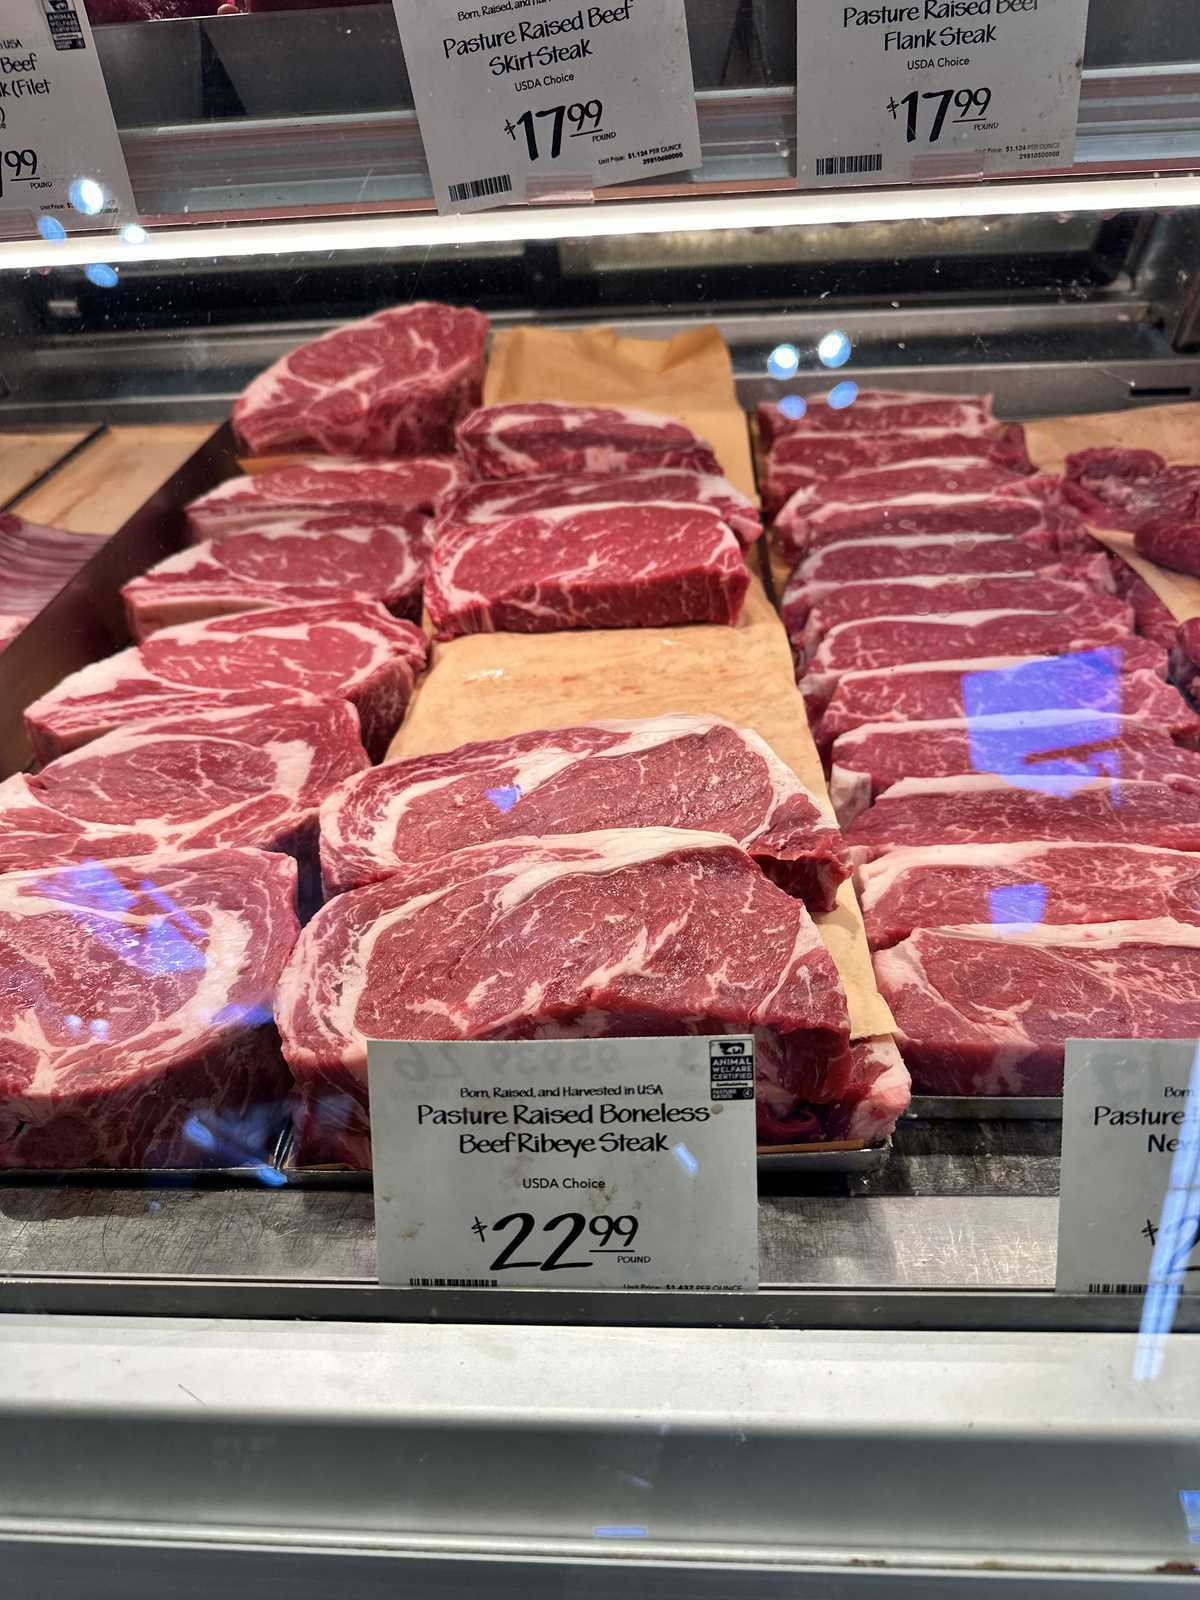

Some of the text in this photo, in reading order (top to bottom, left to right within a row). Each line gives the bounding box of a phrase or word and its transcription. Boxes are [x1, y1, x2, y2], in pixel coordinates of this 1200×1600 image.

[843, 5, 919, 27] Pasture
[924, 0, 990, 20] Raised
[443, 0, 635, 59] Pasture Raised Beef
[884, 24, 997, 51] Flank Steak
[3, 39, 23, 49] USA
[1, 53, 38, 73] Beef
[489, 39, 593, 76] Skirt Steak
[907, 57, 970, 70] USDA Choice
[12, 79, 51, 97] (Filet
[514, 73, 575, 92] USDA Choice
[974, 122, 999, 131] POUND
[592, 132, 617, 142] POUND
[712, 1065, 752, 1073] WELFARE
[712, 1072, 752, 1080] CERTIFIED
[537, 1086, 561, 1097] and
[562, 1085, 622, 1097] Harvested
[623, 1085, 635, 1096] in
[637, 1084, 664, 1095] USA
[417, 1102, 711, 1125] Pasture Raised Boneless
[1094, 1105, 1185, 1126] Pasture
[459, 1131, 669, 1158] Beef Ribeye Steak
[522, 1177, 606, 1189] USDA Choice
[617, 1256, 652, 1264] POUND
